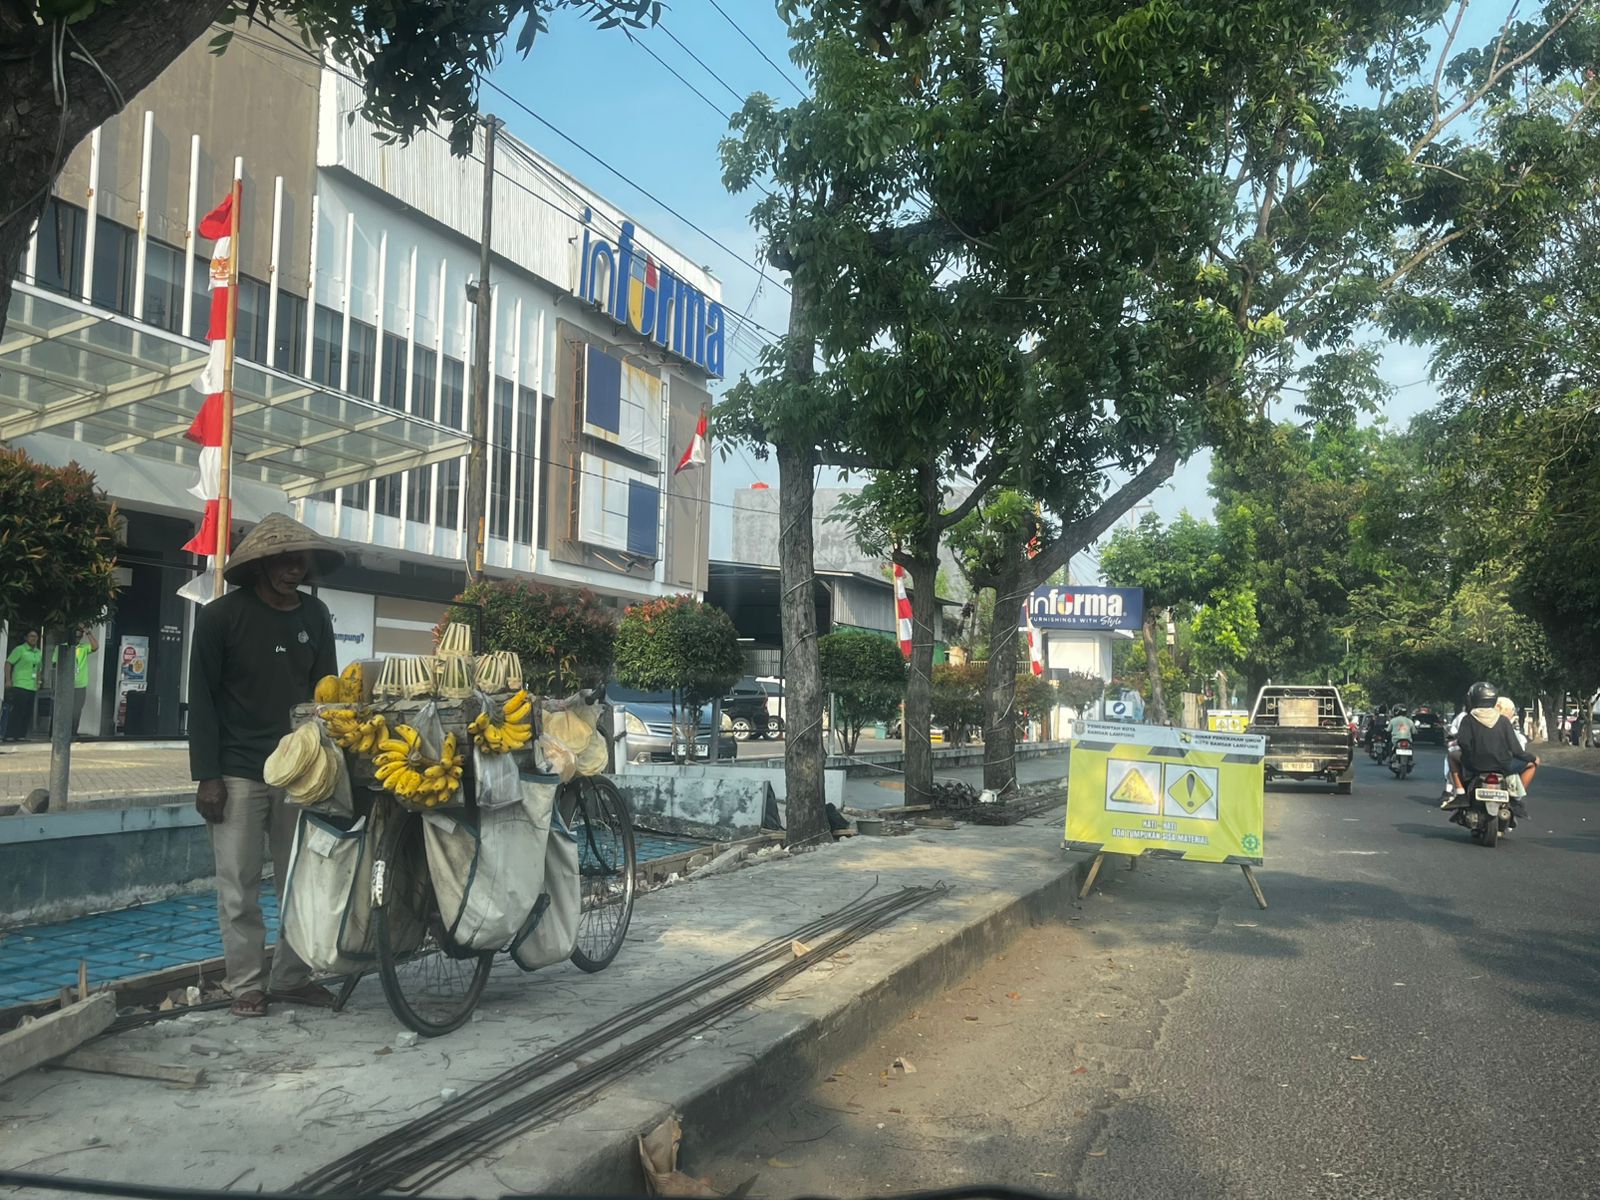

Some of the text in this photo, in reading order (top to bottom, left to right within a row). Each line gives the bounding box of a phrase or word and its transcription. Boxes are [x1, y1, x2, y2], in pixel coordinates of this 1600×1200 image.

[579, 206, 725, 379] informa
[1030, 588, 1123, 617] informa
[1030, 616, 1076, 624] FURNISHINGS
[1100, 615, 1122, 628] Style
[1087, 723, 1121, 731] PEMERINTAH
[1142, 819, 1157, 829] HATI
[1162, 821, 1177, 831] HATI
[1112, 828, 1125, 837] ADA
[1126, 829, 1160, 840] TUMPUKAN
[1177, 834, 1208, 845] MATERIAL
